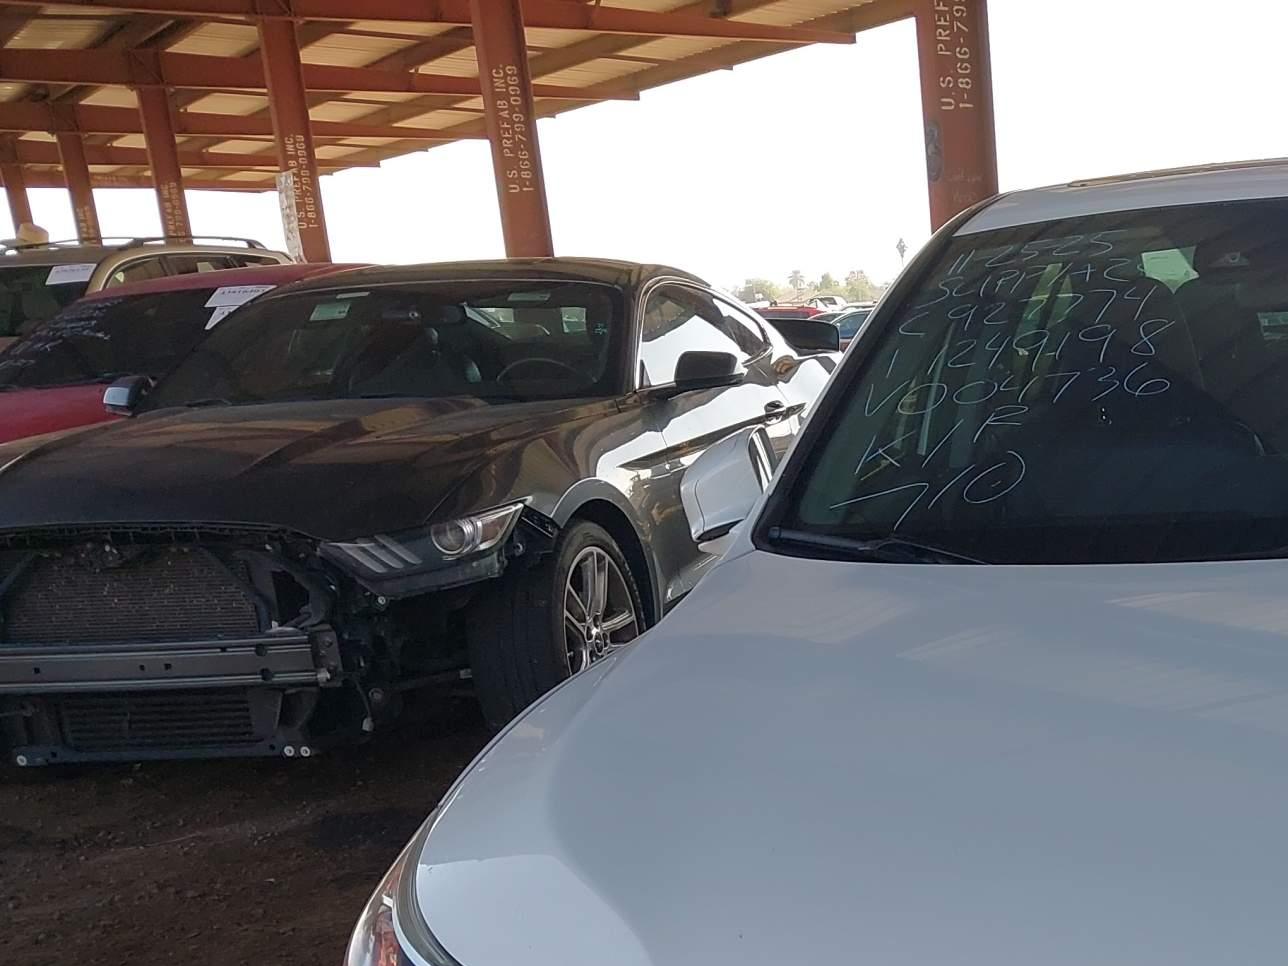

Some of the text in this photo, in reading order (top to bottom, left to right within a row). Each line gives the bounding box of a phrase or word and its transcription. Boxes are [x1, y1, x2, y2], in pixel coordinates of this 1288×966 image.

[492, 64, 507, 92] INC.
[953, 0, 974, 108] 1-866-79
[940, 71, 956, 111] U.S.
[497, 100, 516, 157] PREFAB
[505, 65, 535, 192] 1-866-799-0969
